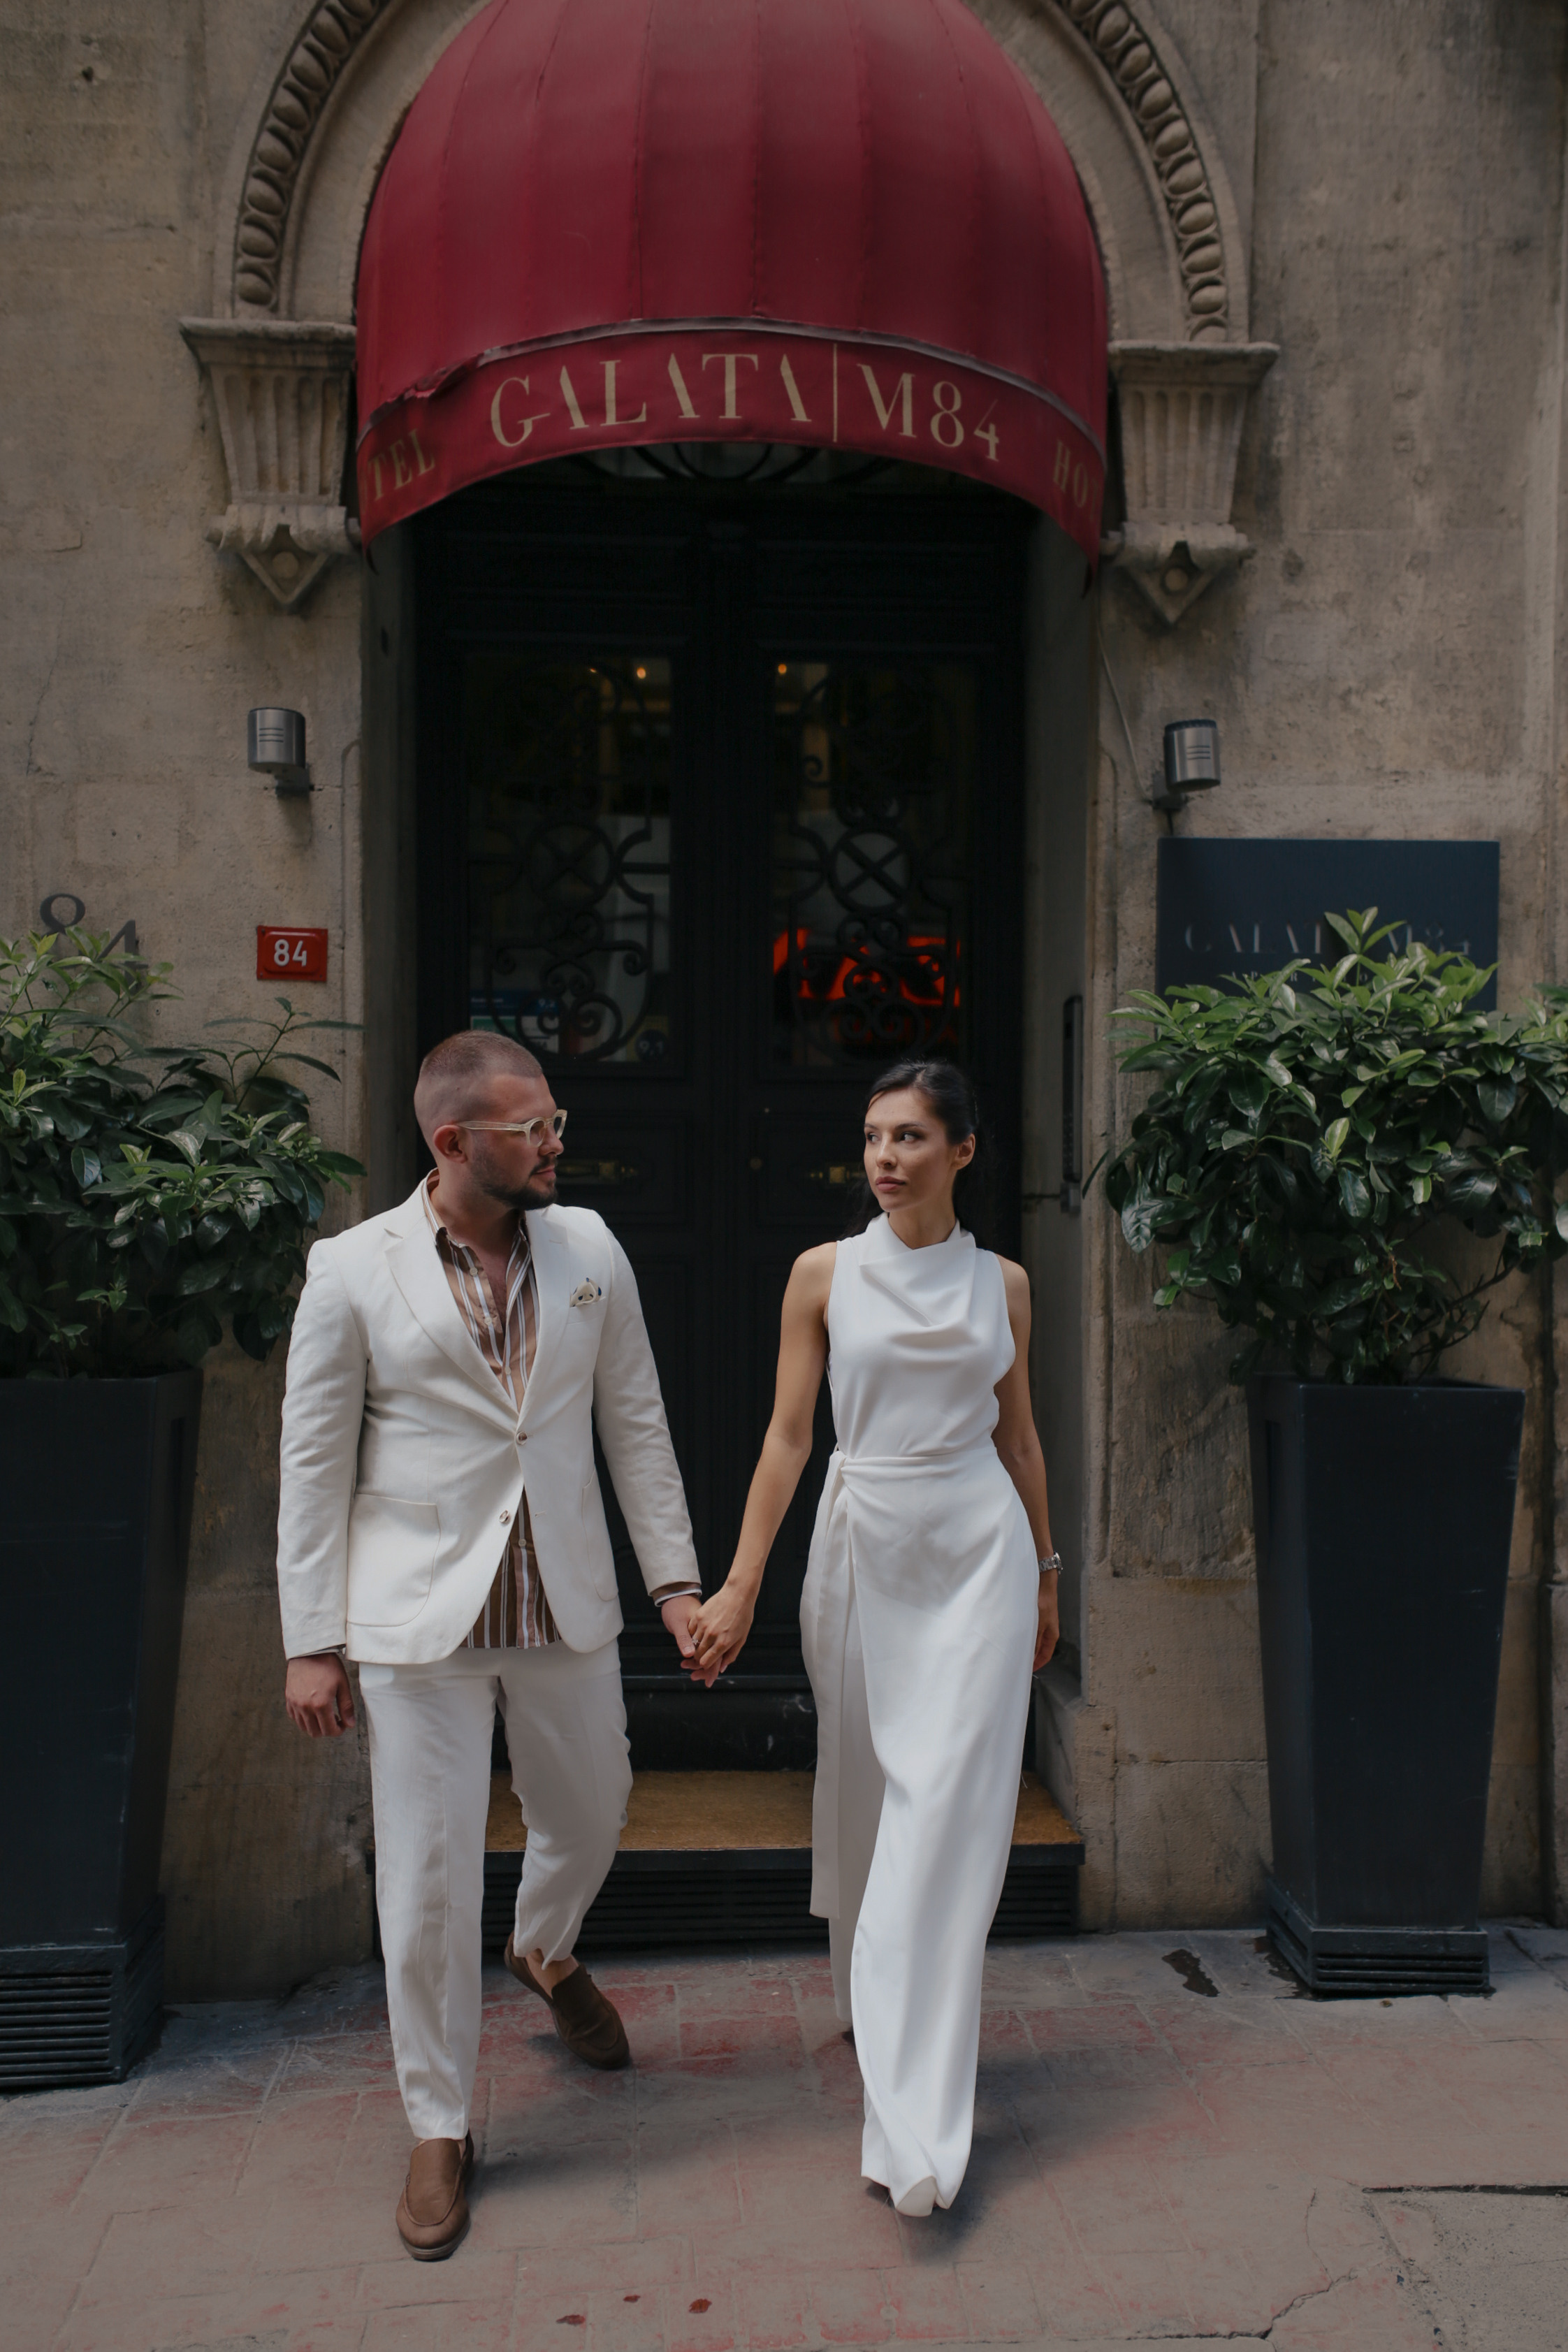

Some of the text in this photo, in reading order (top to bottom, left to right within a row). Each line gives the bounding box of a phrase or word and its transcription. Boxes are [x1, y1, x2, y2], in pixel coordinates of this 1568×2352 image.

[490, 353, 1000, 462] GALATA M84
[358, 428, 435, 515] TEL
[274, 939, 307, 967] 84
[1184, 920, 1358, 955] GALAT
